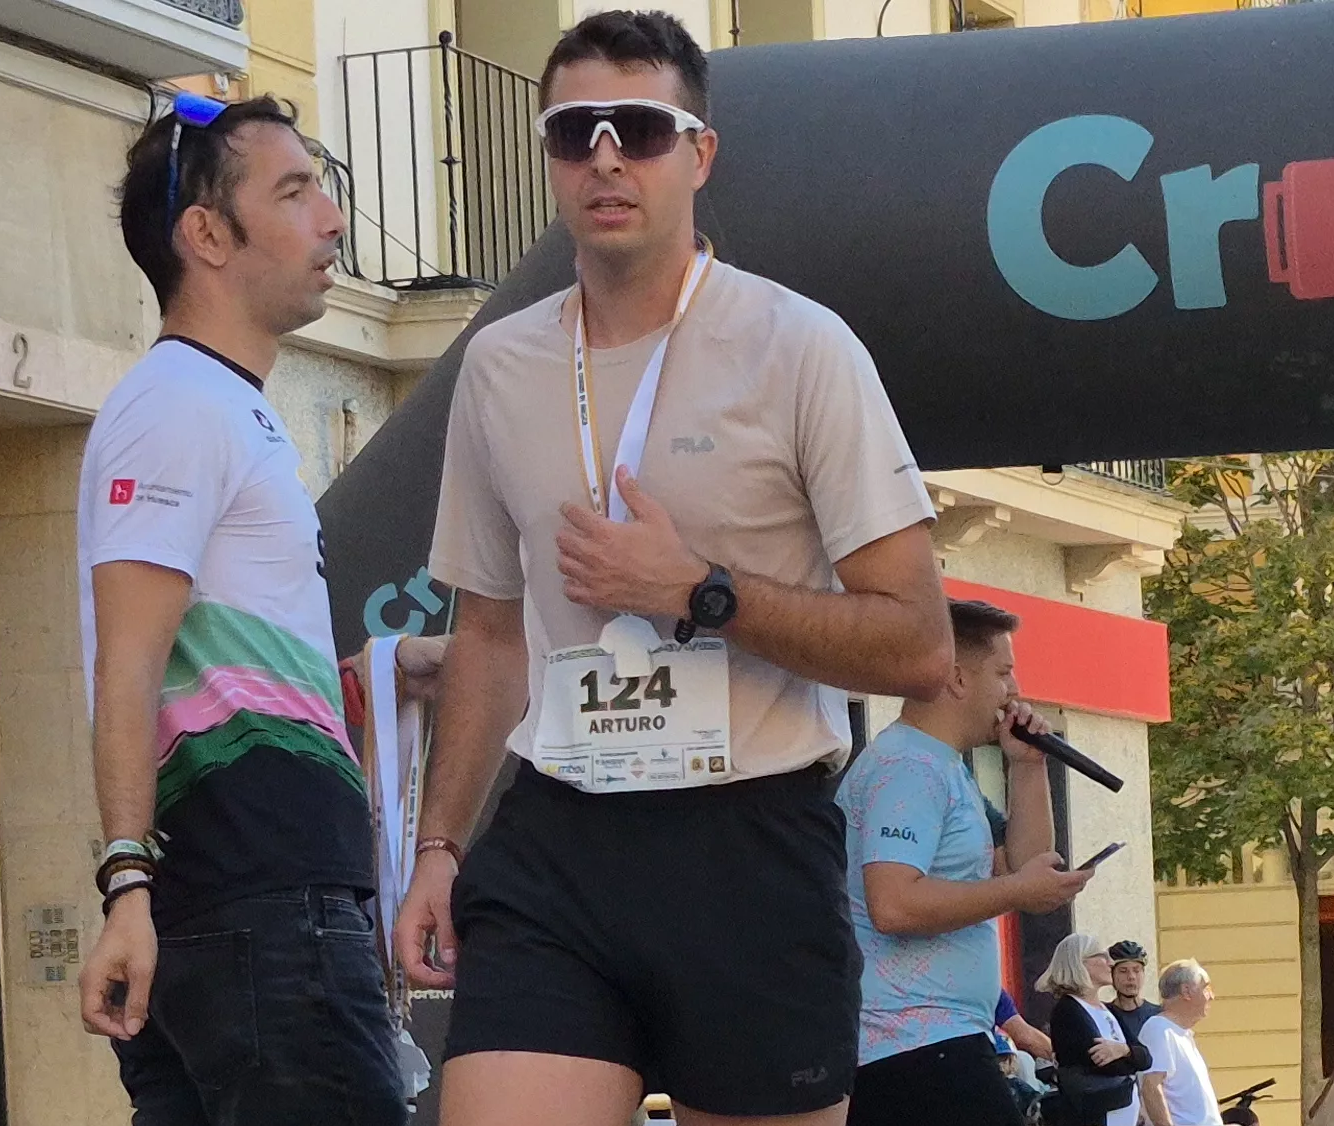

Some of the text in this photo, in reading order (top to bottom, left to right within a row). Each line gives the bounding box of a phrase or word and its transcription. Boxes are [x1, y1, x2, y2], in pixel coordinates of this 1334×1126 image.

[12, 332, 32, 389] 2
[580, 665, 678, 714] 124
[588, 714, 666, 734] ARTURO
